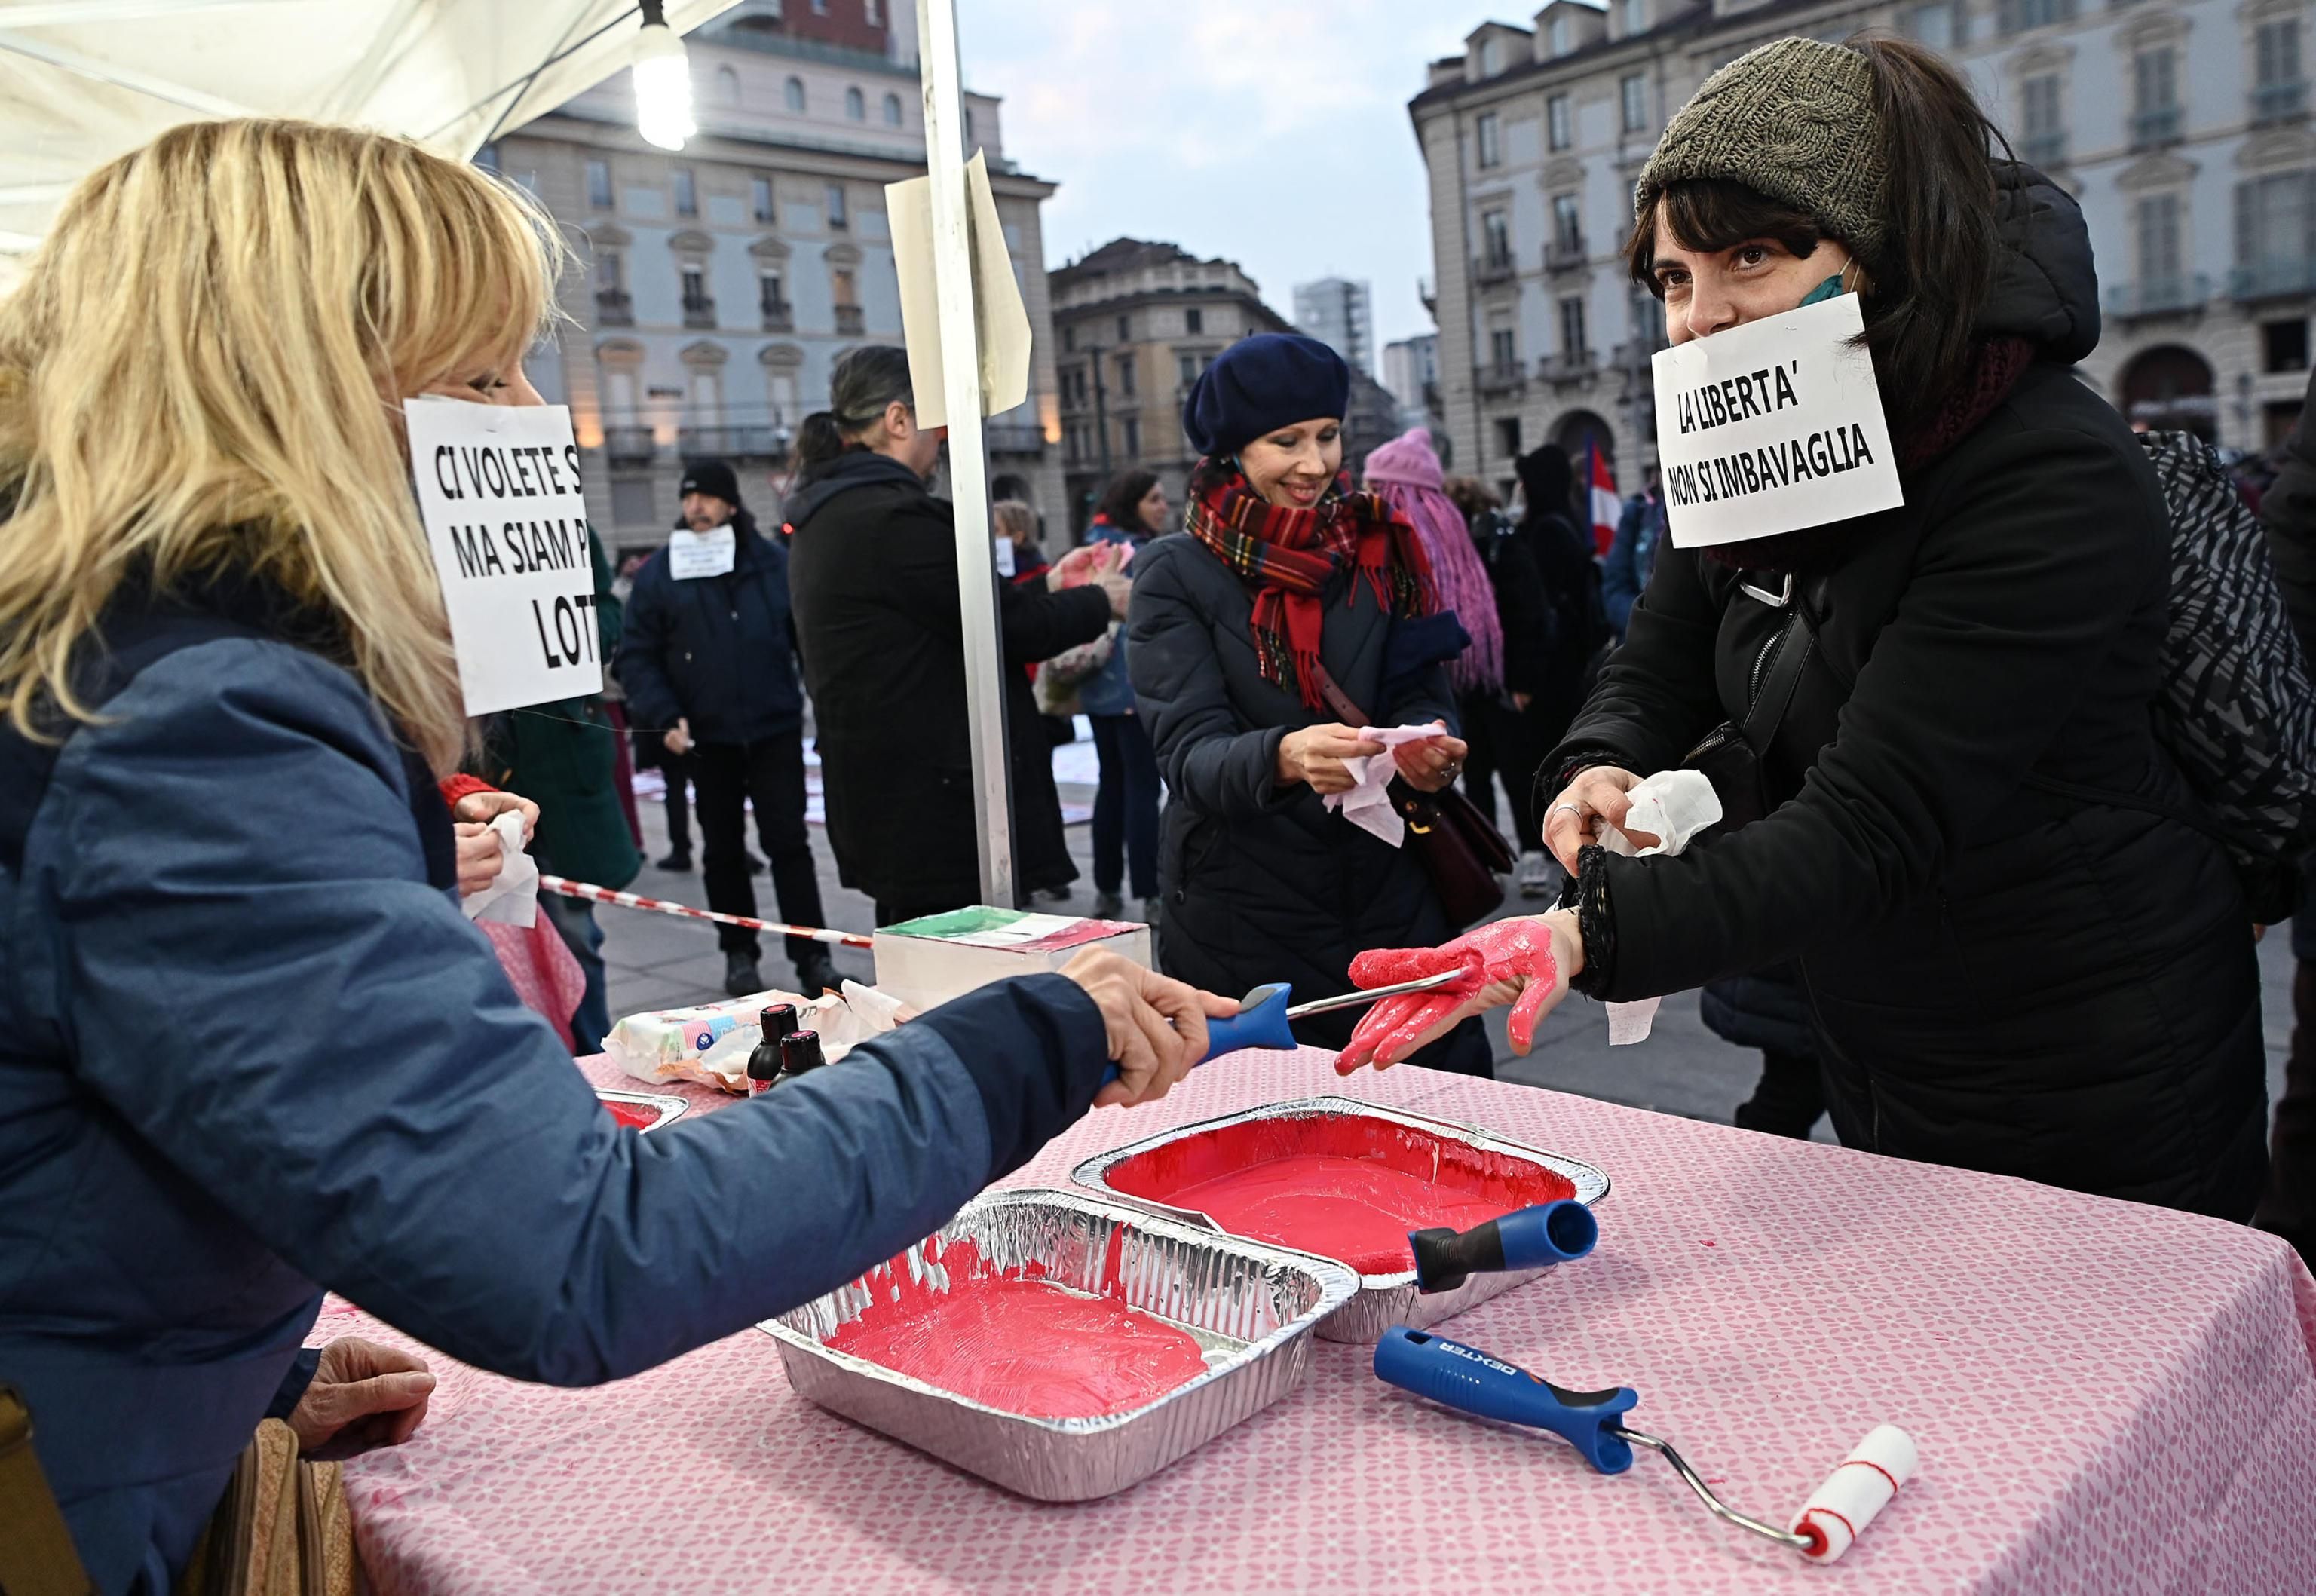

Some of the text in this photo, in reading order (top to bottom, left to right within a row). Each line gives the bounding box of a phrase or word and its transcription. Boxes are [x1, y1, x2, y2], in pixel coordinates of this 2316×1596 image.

[1678, 391, 1696, 435] LA
[435, 444, 464, 499] CI
[461, 446, 565, 498] VOLETE
[1668, 423, 1875, 507] NON SI IMBAVAGLIA
[450, 523, 505, 578] MA
[503, 519, 574, 574] SIAM
[1439, 1341, 1518, 1376] DEXTER
